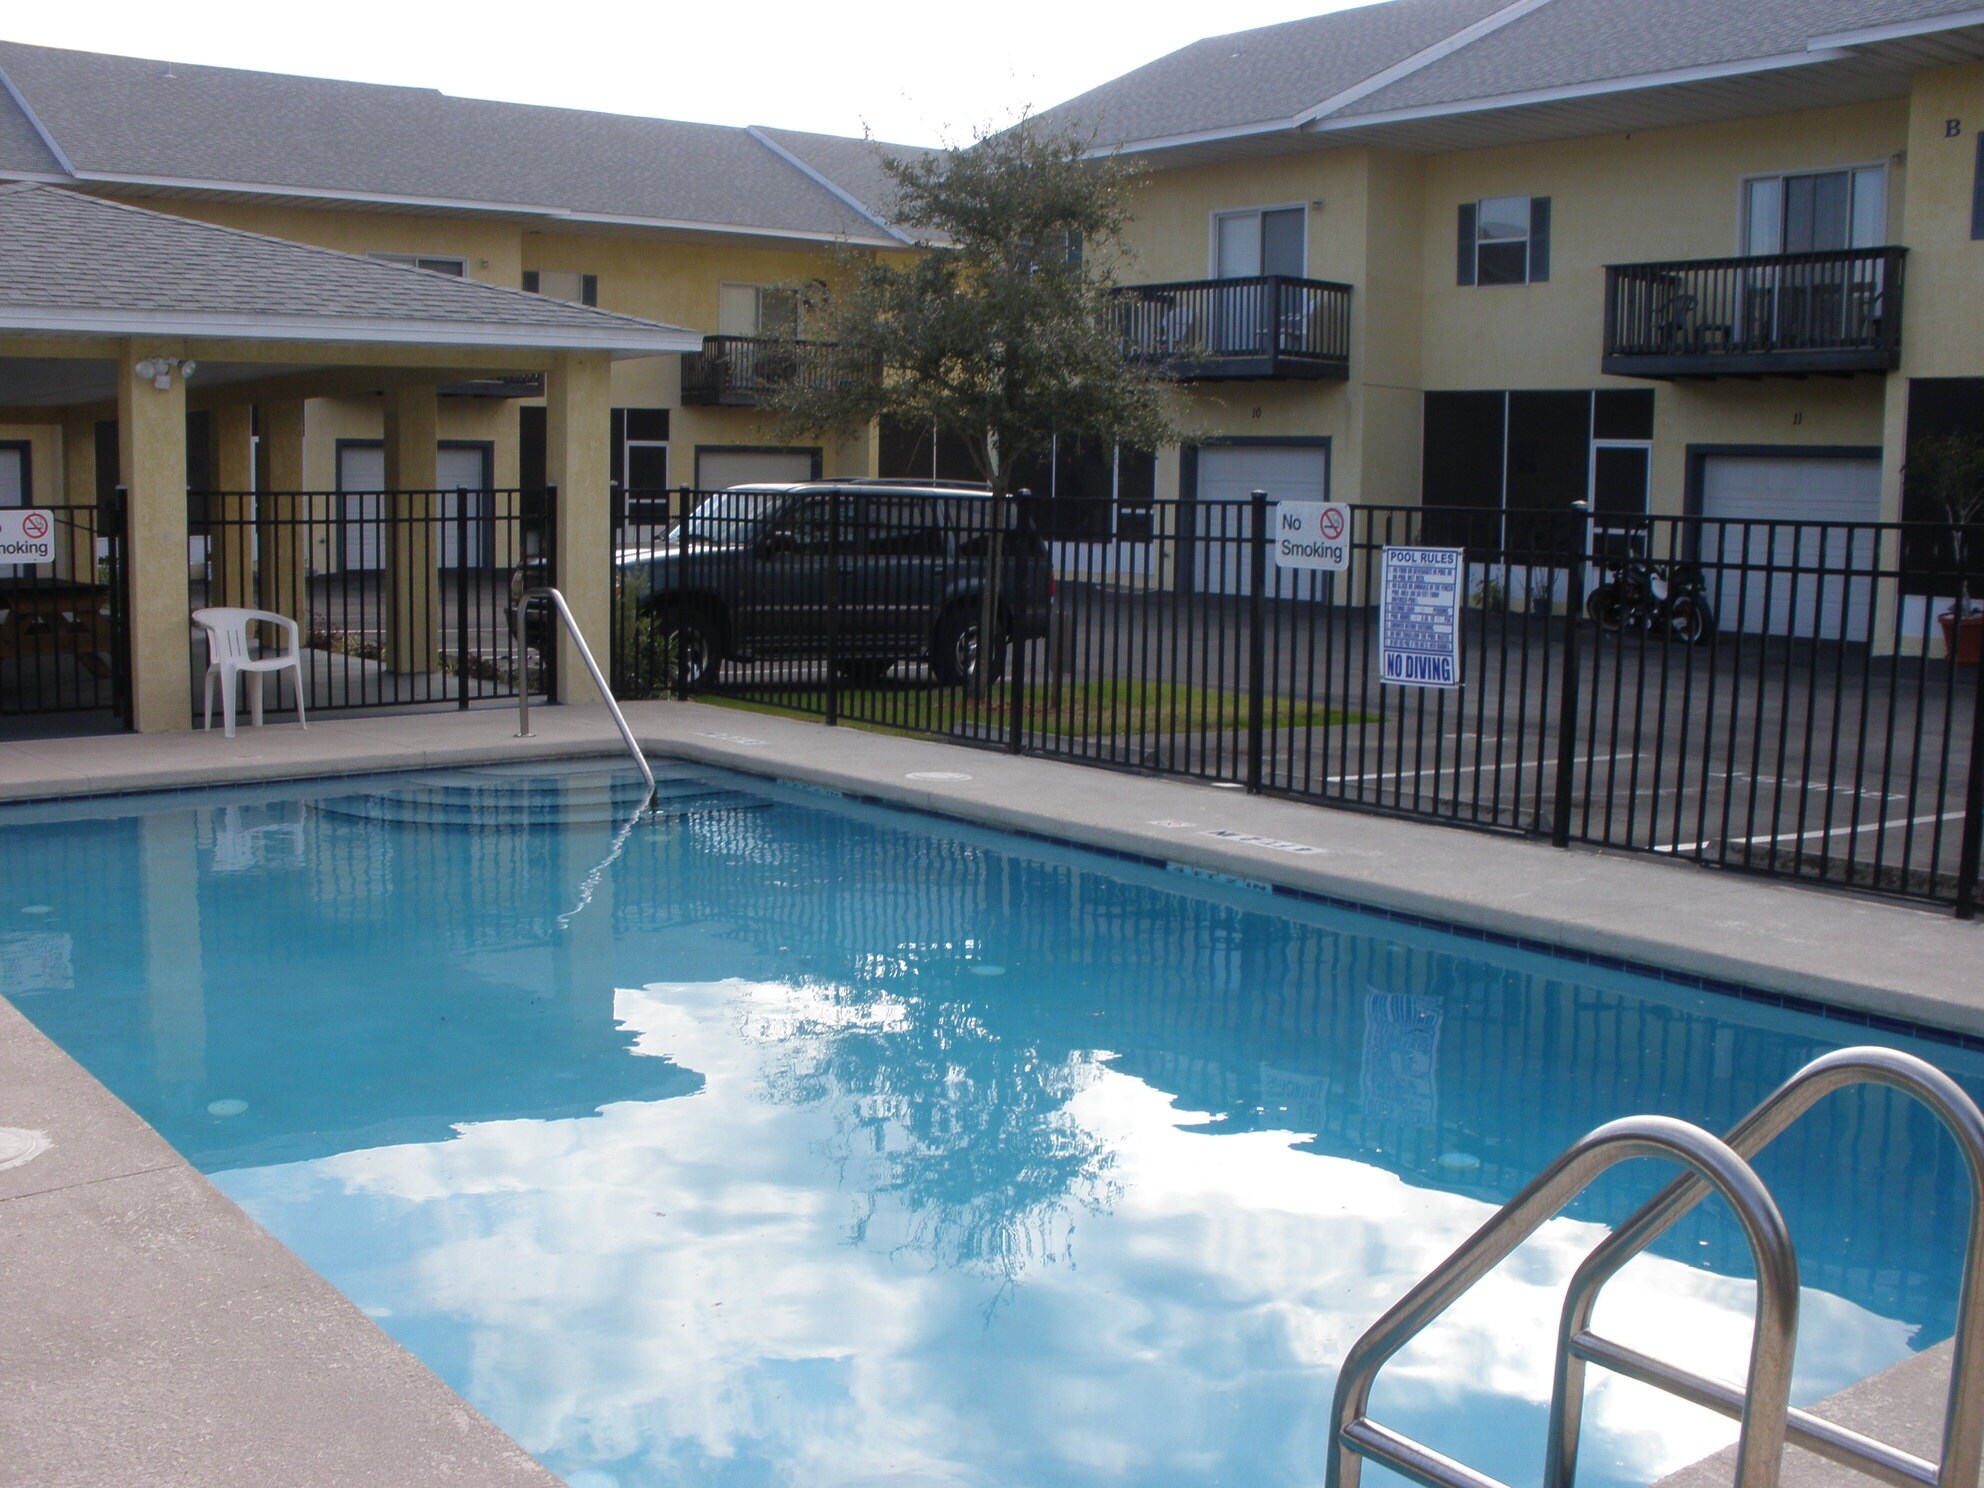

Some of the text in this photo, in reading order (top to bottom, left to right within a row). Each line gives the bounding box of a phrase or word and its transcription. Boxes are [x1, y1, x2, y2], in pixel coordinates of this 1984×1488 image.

[1944, 118, 1961, 138] B
[1252, 407, 1261, 418] 10
[1793, 411, 1802, 425] 11
[1282, 514, 1301, 530] No
[1282, 539, 1343, 564] Smoking
[1391, 551, 1454, 564] POOL RULES
[1387, 653, 1451, 681] NO DIVING
